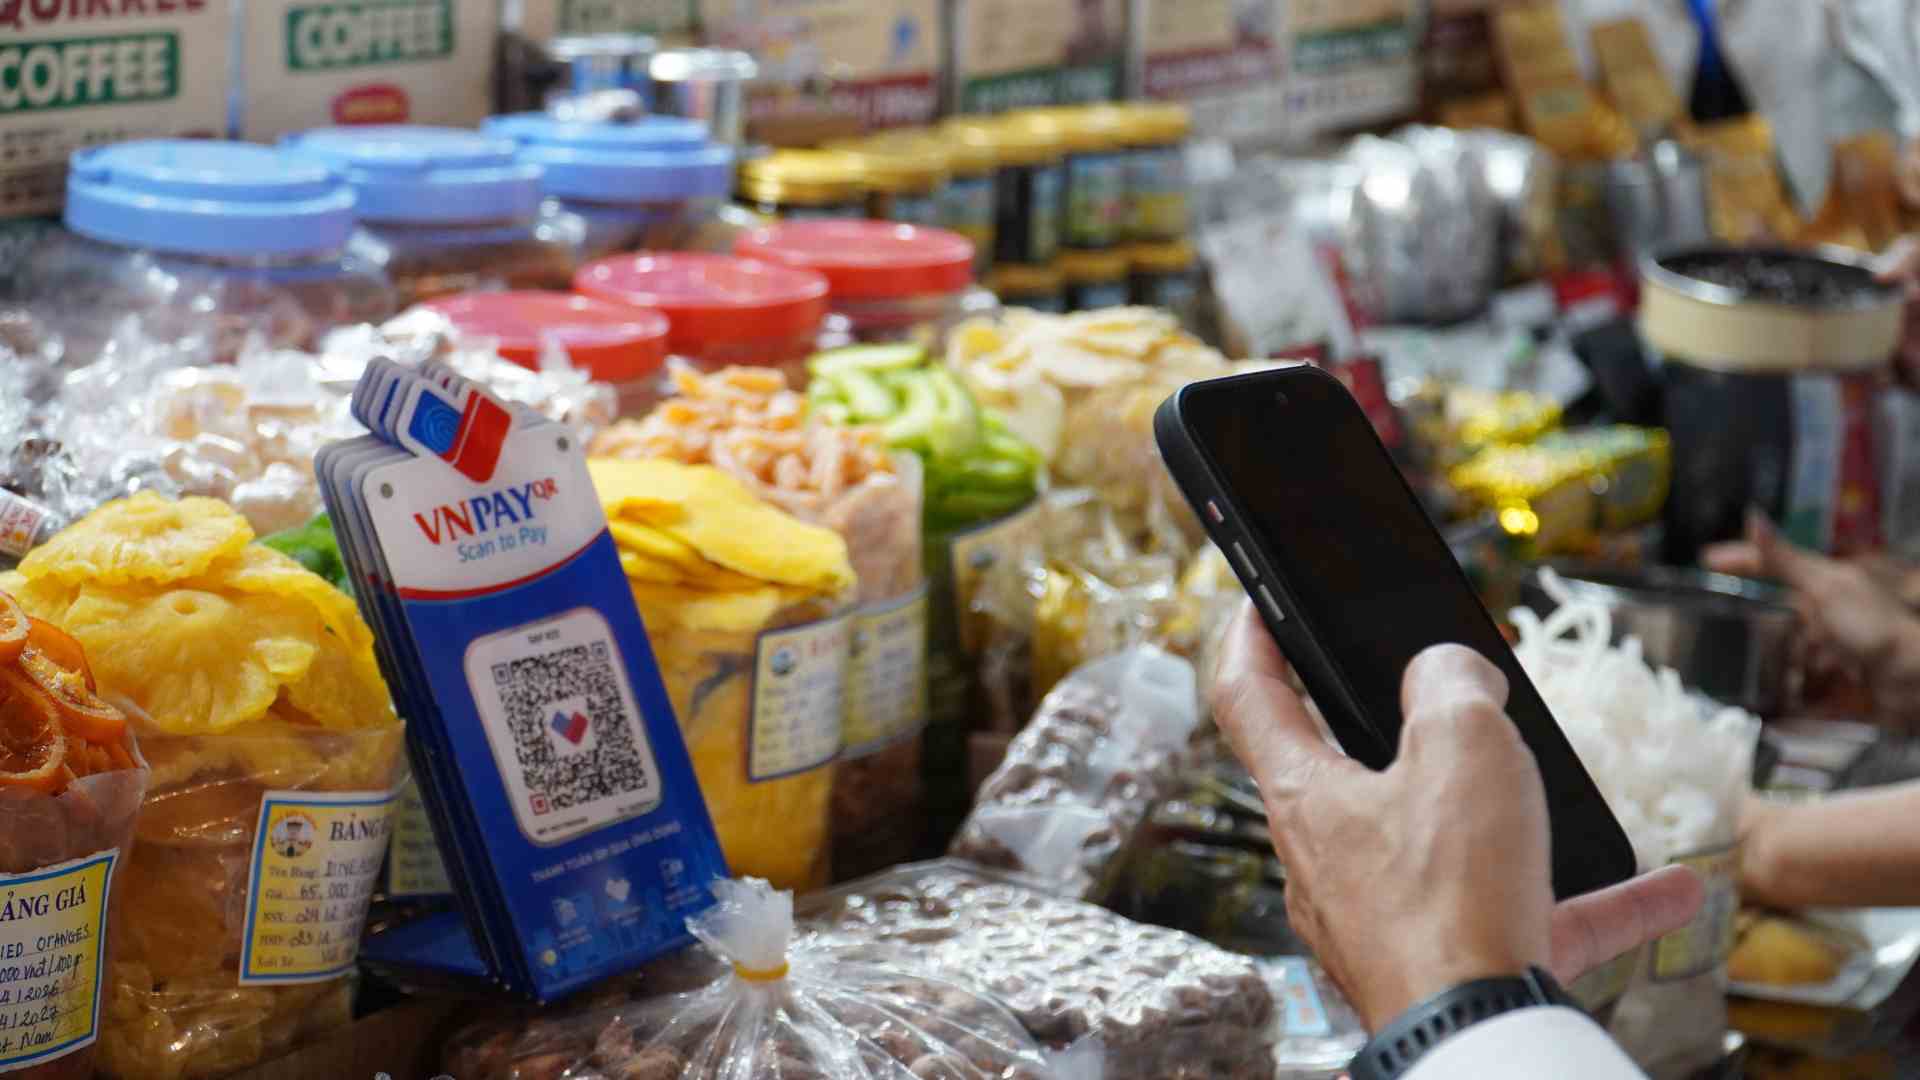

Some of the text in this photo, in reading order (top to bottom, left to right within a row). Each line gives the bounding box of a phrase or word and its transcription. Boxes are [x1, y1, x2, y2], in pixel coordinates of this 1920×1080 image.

[298, 4, 438, 62] COFFEE
[0, 38, 167, 109] COFFEE
[457, 526, 547, 563] Scan to Pay
[55, 876, 87, 913] GIÁ
